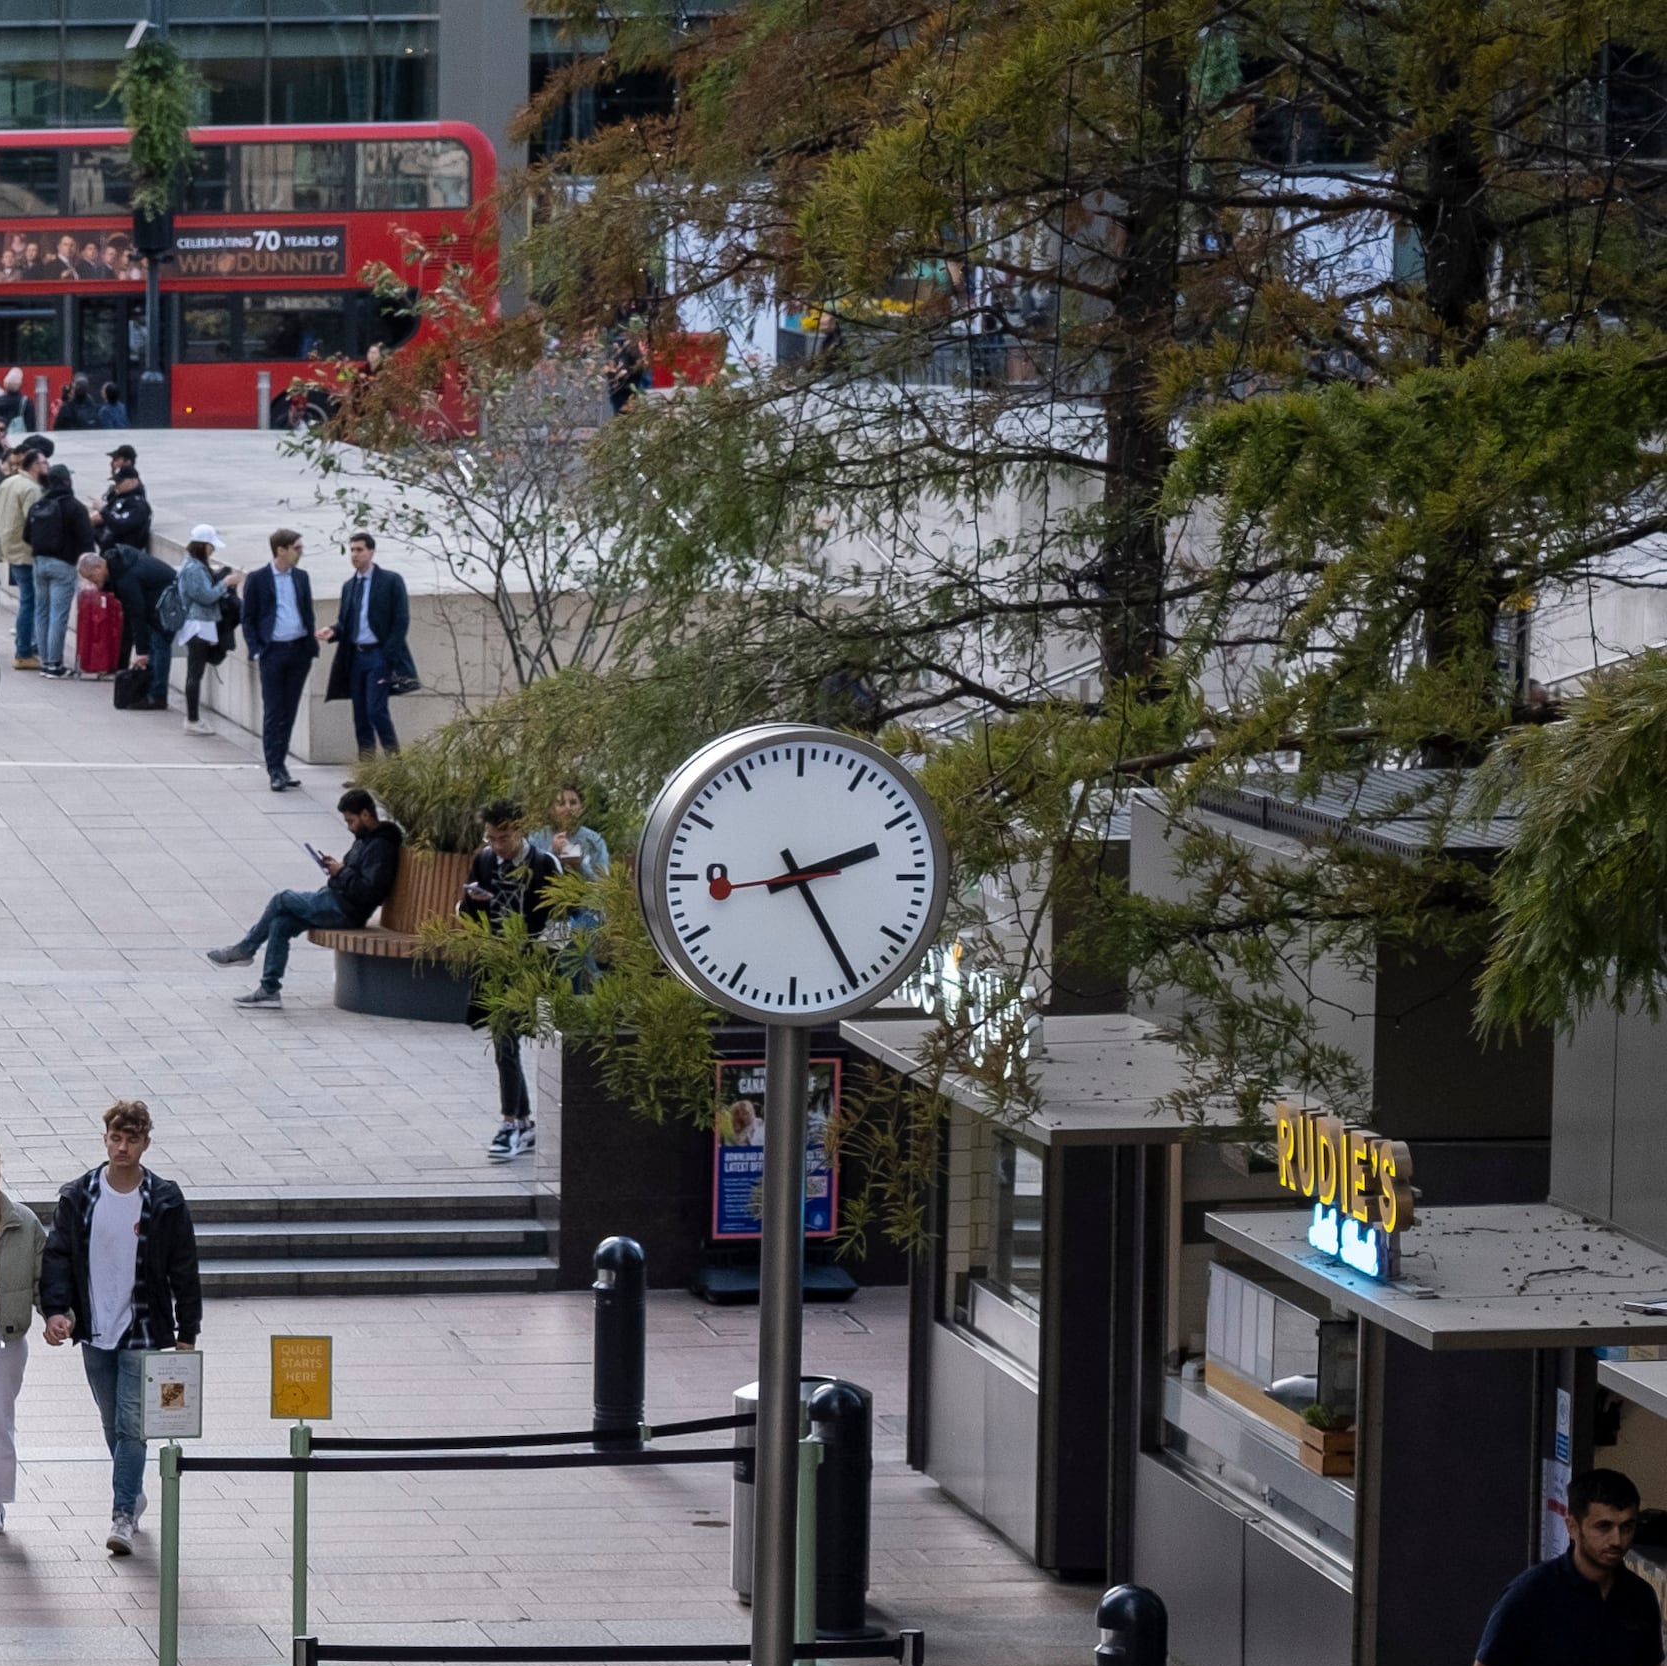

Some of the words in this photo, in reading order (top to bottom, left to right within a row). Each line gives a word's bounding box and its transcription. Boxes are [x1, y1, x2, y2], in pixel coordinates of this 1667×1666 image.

[176, 236, 253, 249] CELEBRATING
[253, 230, 281, 251] 70
[283, 235, 320, 248] YEARS
[322, 236, 339, 247] OF
[177, 251, 339, 274] WHODUNNIT?
[1276, 1101, 1400, 1234] RUDIE'S
[281, 1344, 324, 1356] QUEUE
[281, 1358, 324, 1369] STARTS
[286, 1371, 318, 1383] HERE
